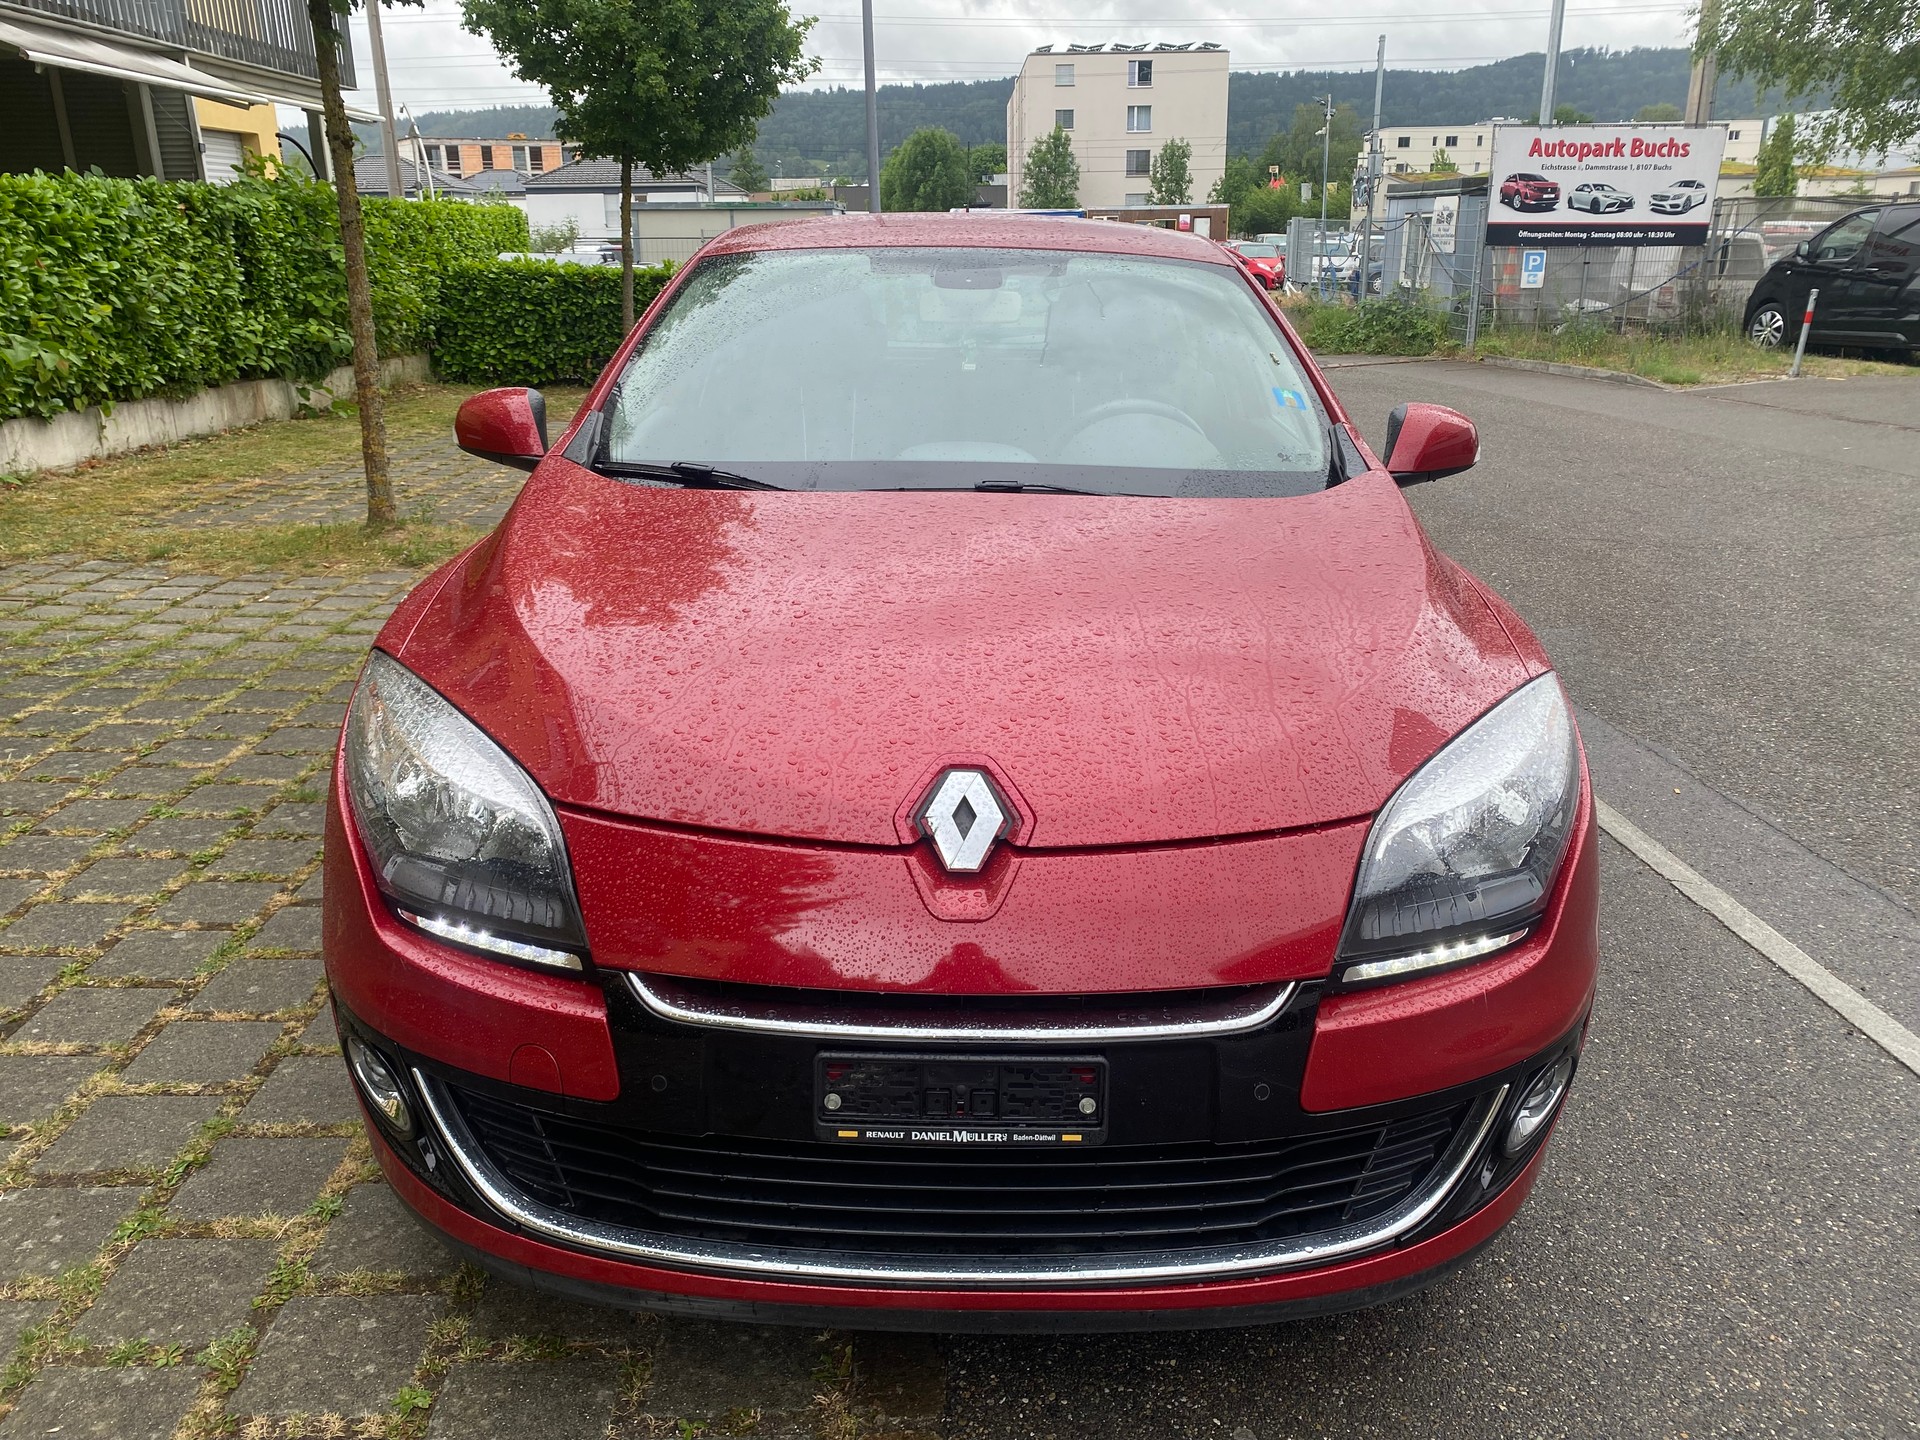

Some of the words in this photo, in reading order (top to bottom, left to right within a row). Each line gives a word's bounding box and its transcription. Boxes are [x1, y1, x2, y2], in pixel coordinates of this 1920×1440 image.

[1528, 137, 1626, 162] Autopark
[1630, 137, 1690, 158] Buchs
[1541, 163, 1577, 171] Eichstrasse
[1585, 163, 1628, 171] Dammstrasse
[1636, 163, 1653, 171] 8107
[1653, 163, 1673, 171] Buchs
[1518, 229, 1564, 239] Öffnungszeiten:
[1564, 231, 1587, 239] Montag
[1590, 231, 1616, 240] Samstag
[1528, 255, 1542, 271] P
[866, 1131, 905, 1139] RENAULT
